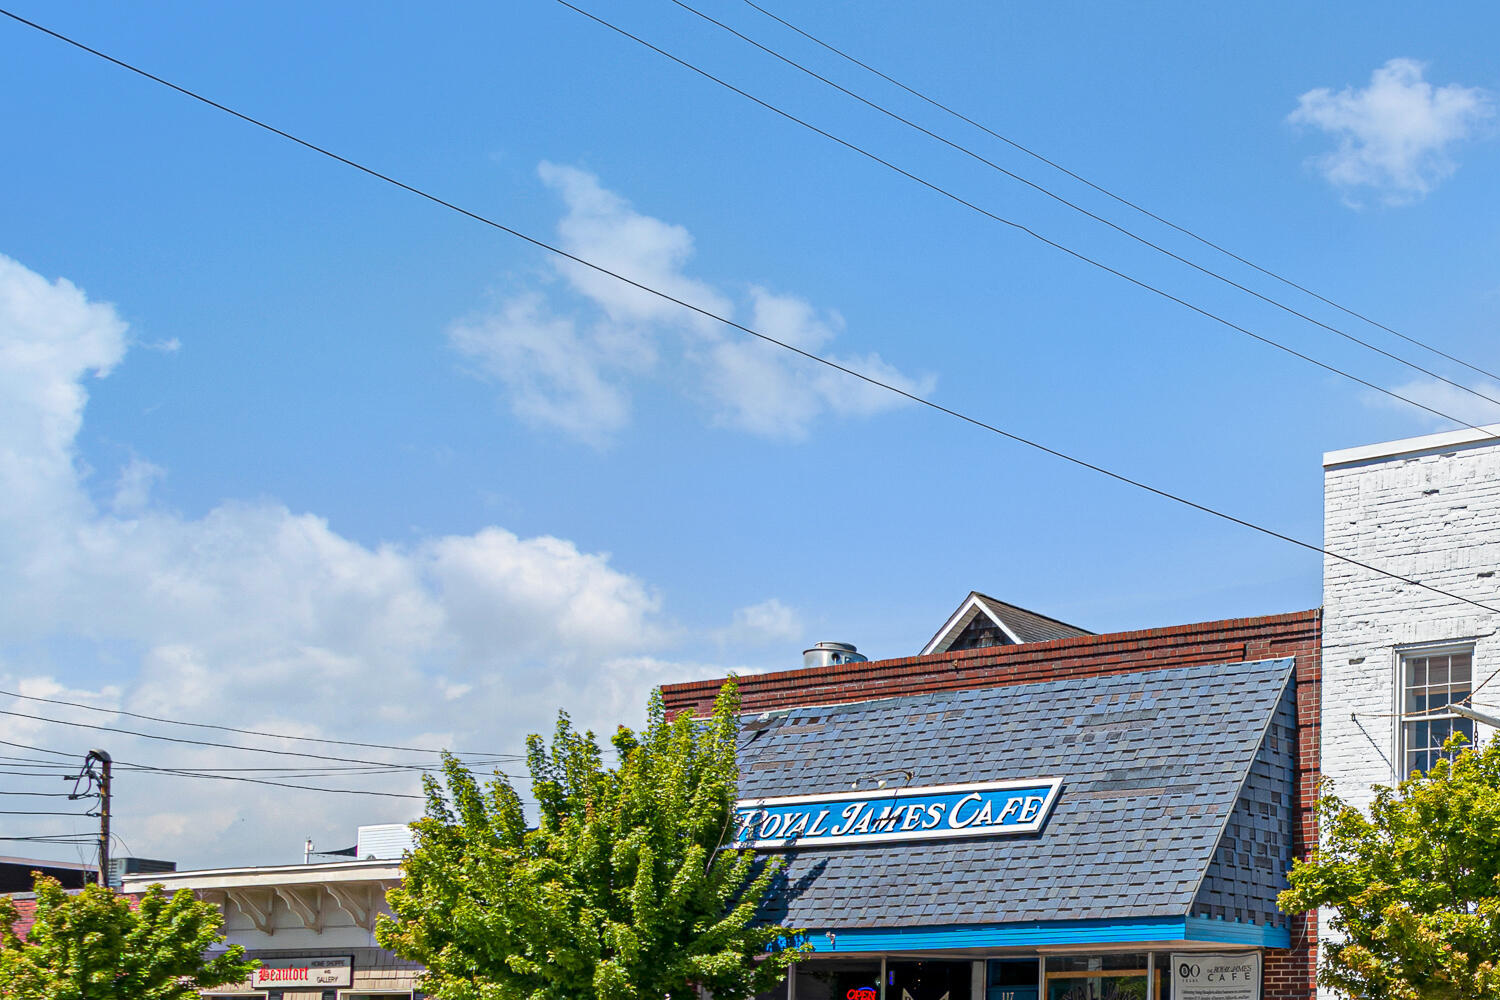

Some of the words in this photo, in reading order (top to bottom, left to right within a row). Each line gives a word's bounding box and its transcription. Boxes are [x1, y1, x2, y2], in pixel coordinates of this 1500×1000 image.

[737, 809, 832, 839] ROYAL
[832, 801, 949, 836] JAMES
[948, 792, 1044, 829] CAFE
[258, 963, 308, 984] Beaufort
[1207, 971, 1251, 982] CAFE
[847, 989, 876, 1000] OPEN
